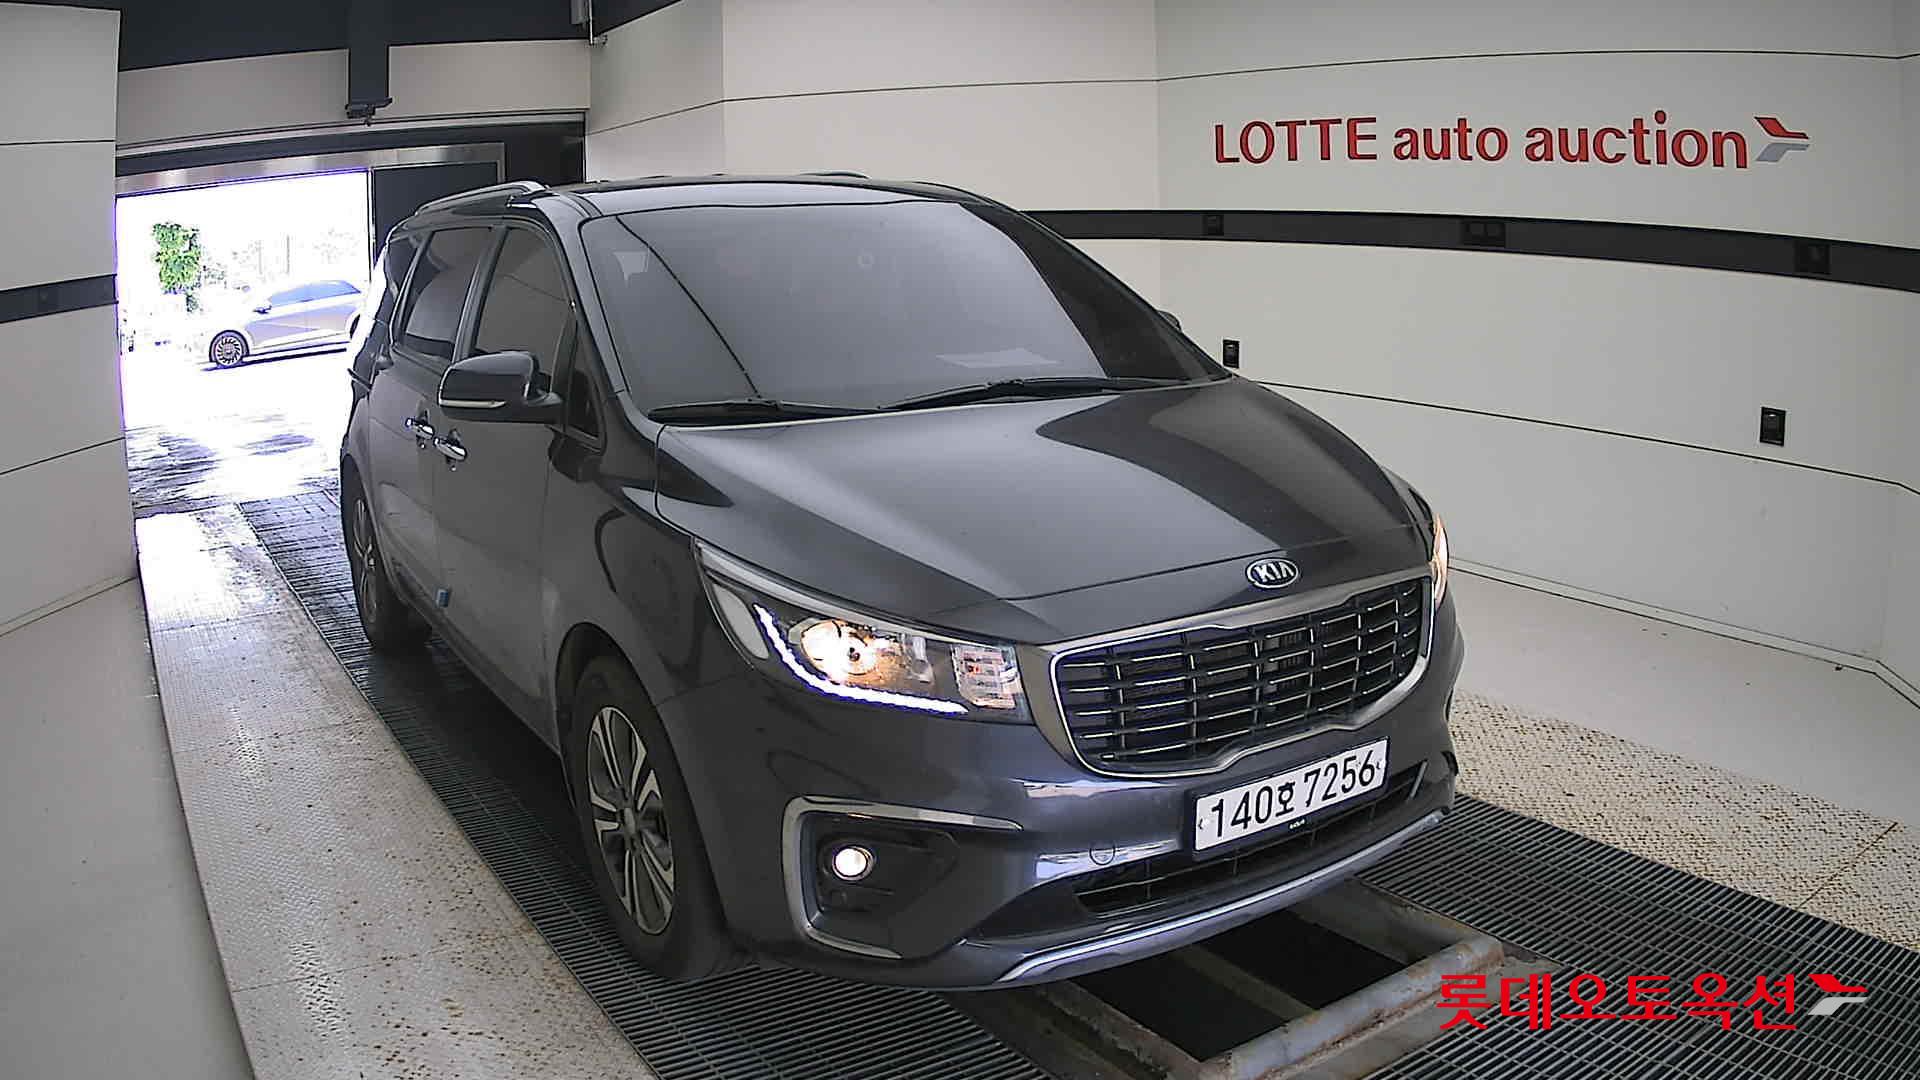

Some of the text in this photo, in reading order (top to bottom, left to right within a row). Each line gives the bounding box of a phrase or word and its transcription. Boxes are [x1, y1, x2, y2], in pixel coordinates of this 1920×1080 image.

[1214, 110, 1749, 169] LOTTE auto auction
[1253, 561, 1295, 583] KIA
[1211, 749, 1376, 838] 140호 7256
